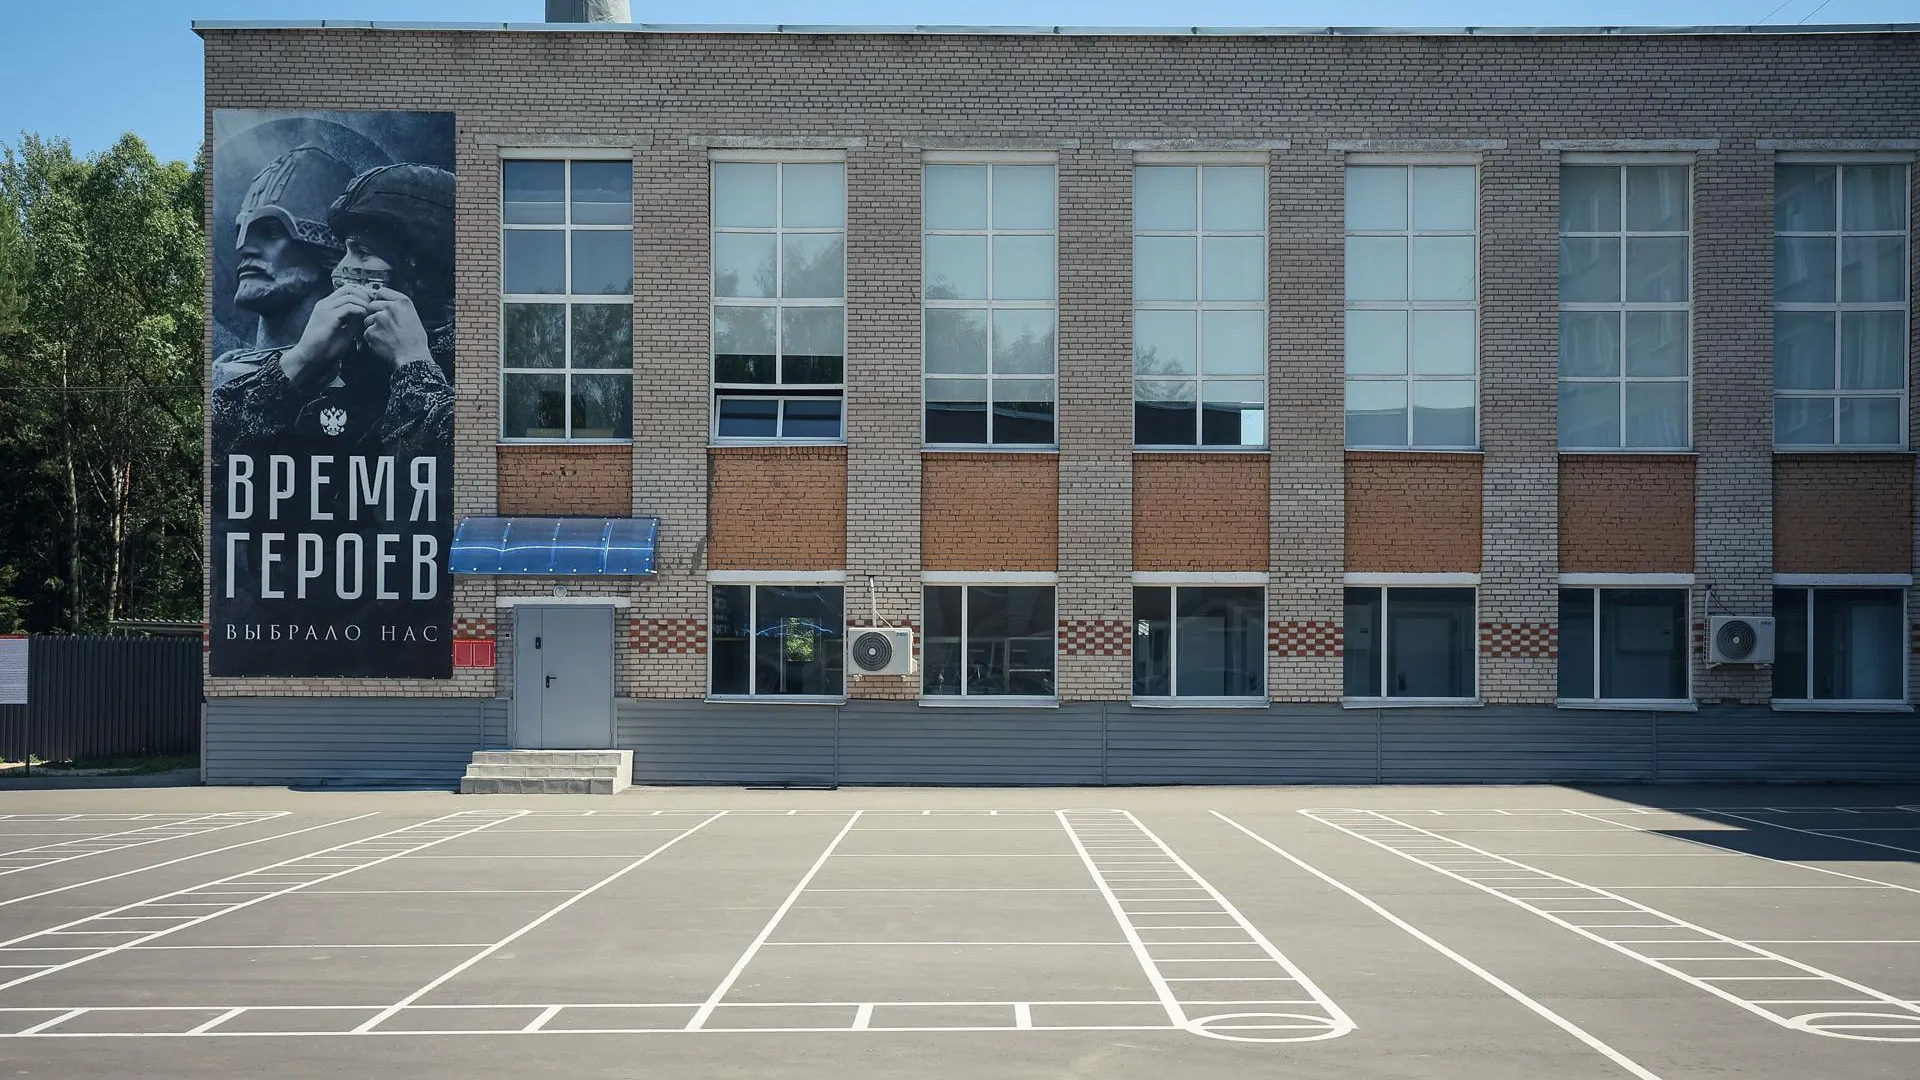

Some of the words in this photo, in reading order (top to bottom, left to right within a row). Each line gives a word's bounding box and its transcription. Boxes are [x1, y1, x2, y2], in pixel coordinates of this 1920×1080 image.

[227, 454, 437, 522] ВРЕМЯ
[226, 532, 438, 600] ГЕРОЕВ
[226, 624, 361, 641] ВЫБРАЛО
[381, 625, 438, 642] НАС
